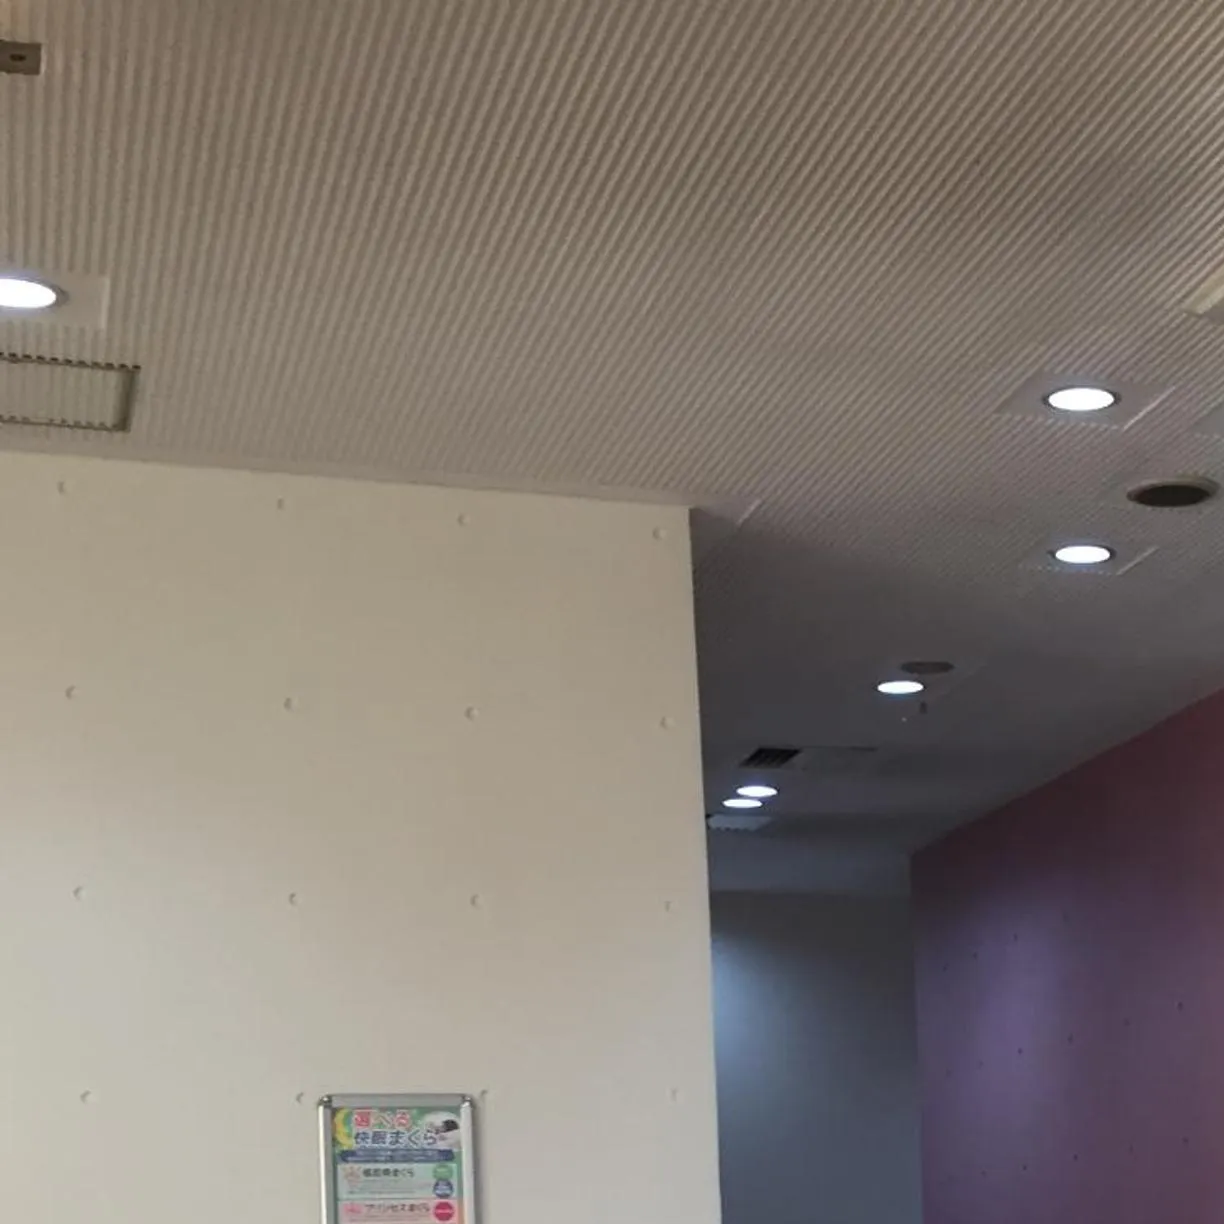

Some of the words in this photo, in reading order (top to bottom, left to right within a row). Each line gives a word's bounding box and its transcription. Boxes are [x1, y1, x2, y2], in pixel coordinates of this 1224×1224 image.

[354, 1129, 438, 1146] 快眠まくら
